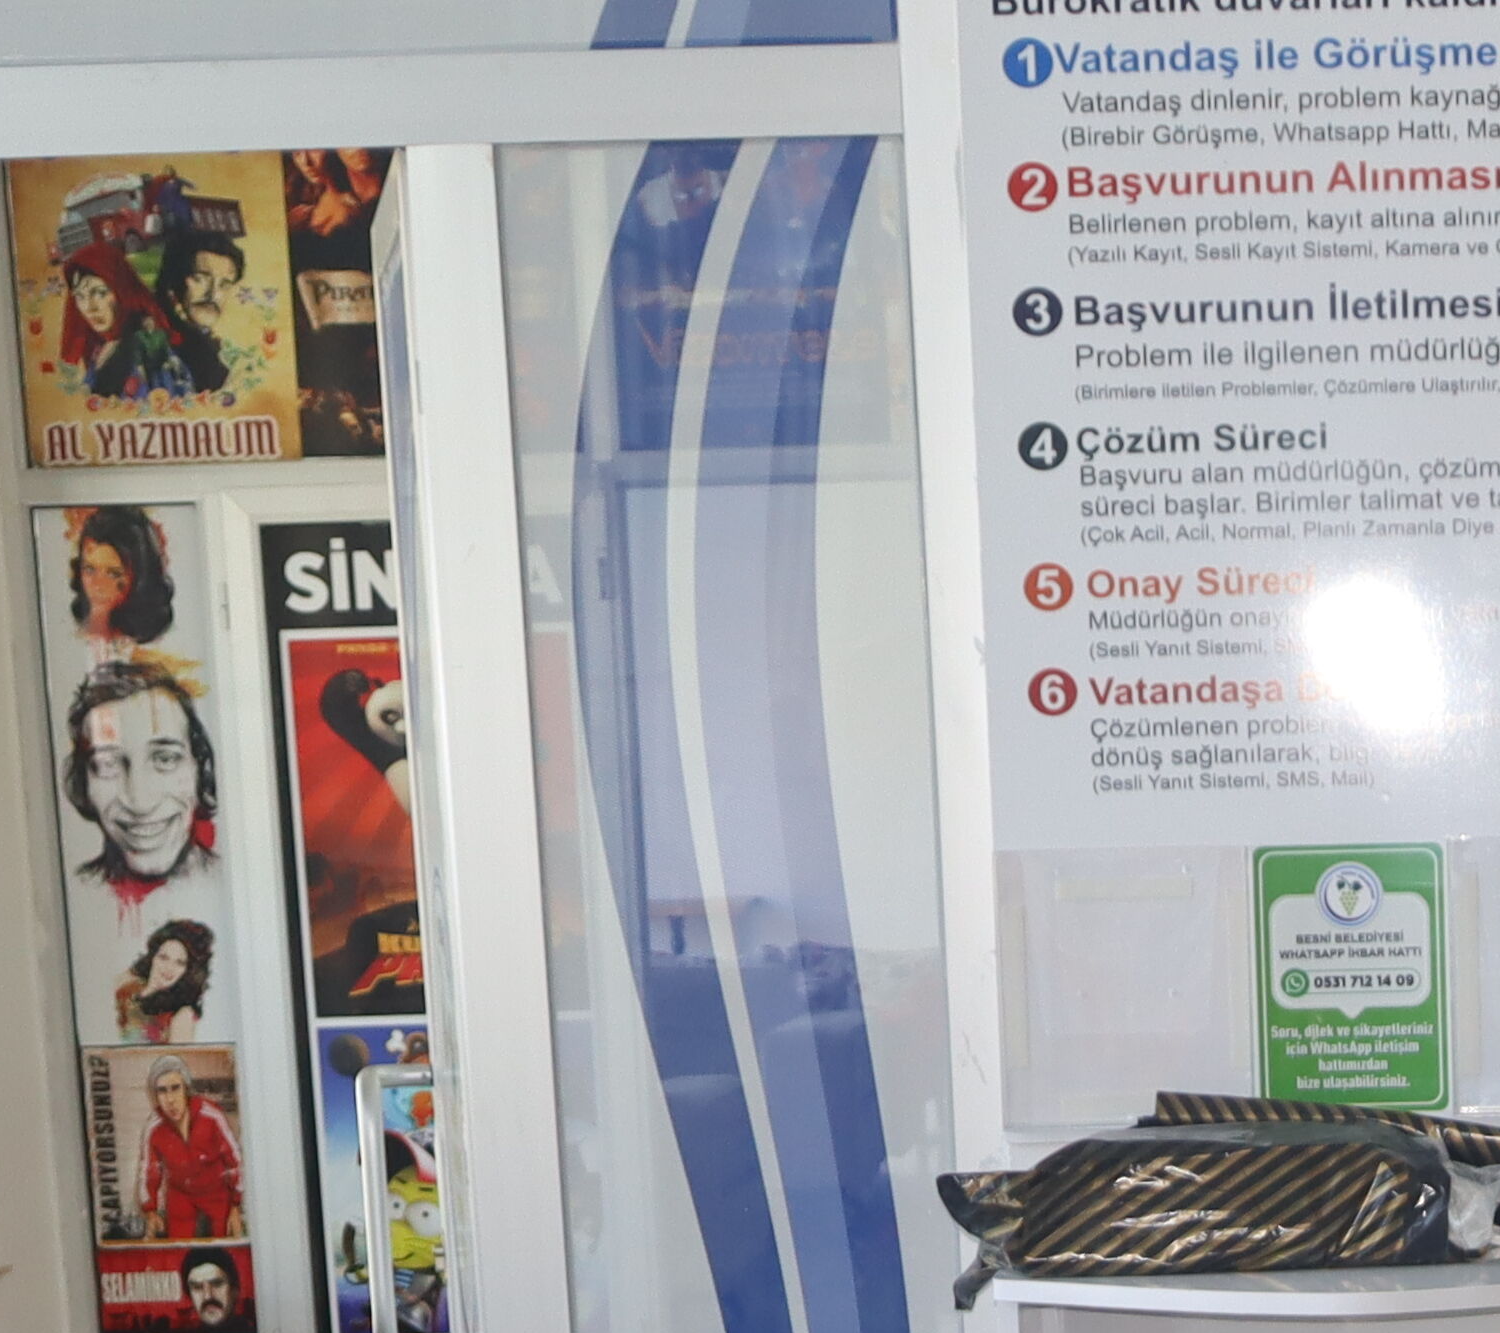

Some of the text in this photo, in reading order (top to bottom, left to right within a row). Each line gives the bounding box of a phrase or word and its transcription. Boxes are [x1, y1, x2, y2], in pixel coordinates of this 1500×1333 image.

[1054, 41, 1239, 78] Vatandaş
[1255, 39, 1298, 70] ile
[1314, 37, 1497, 75] Görüşme
[1062, 91, 1181, 117] Vatandaş
[1191, 88, 1287, 112] dinlenir,
[1299, 87, 1400, 114] problem
[1062, 126, 1144, 151] (Birebir
[1153, 125, 1264, 149] Görüşme,
[1273, 123, 1389, 145] Whatsapp
[1398, 121, 1457, 141] Hattı,
[1068, 167, 1313, 204] Başvurunun
[1069, 213, 1186, 234] Belirlenen
[1196, 211, 1297, 237] problem,
[1307, 210, 1362, 234] kayıt
[1371, 208, 1434, 228] altına
[1068, 246, 1126, 267] (Yazılı
[1134, 245, 1187, 265] Kayıt,
[1196, 243, 1240, 261] Sesli
[1248, 242, 1296, 262] Kayıt
[1303, 240, 1377, 259] Sistemi,
[1386, 239, 1460, 256] Kamera
[1467, 242, 1488, 255] ve
[1075, 296, 1313, 332] Başvurunun
[1076, 344, 1192, 368] Problem
[1204, 342, 1233, 365] ile
[1245, 341, 1358, 370] ilgilenen
[48, 418, 278, 462] AL YAZMALIM
[1077, 427, 1200, 460] Çözüm
[1215, 423, 1326, 452] Süreci
[1080, 461, 1182, 491] Başvuru
[1192, 462, 1243, 484] alan
[1254, 460, 1408, 485] müdürlüğün,
[1419, 458, 1500, 484] çözüm
[1081, 494, 1155, 517] süreci
[1165, 493, 1245, 520] başlar.
[1256, 491, 1351, 512] Birimler
[1360, 489, 1442, 510] talimat
[1452, 492, 1479, 508] ve
[1087, 569, 1183, 604] Onay
[1089, 609, 1222, 633] Müdürlüğün
[1090, 642, 1139, 662] (Sesli
[1145, 640, 1191, 656] Yanıt
[1197, 640, 1266, 656] Sistemi,
[1089, 675, 1285, 709] Vatandaşa
[1090, 716, 1238, 744] Çözümlenen
[1091, 747, 1163, 771] dönüş
[1171, 744, 1319, 769] sağlanılarak,
[1092, 770, 1374, 796] (Sesli Yanıt Sistemi, SMS, Mail)
[1296, 930, 1404, 945] BESNİ BELEDİYESİ
[1279, 948, 1345, 960] WHATSAPP
[1388, 946, 1422, 958] HATTI
[1314, 974, 1414, 988] 0531 712 14 09
[1271, 1025, 1302, 1040] Soru,
[1337, 1026, 1350, 1037] ve
[1310, 1040, 1372, 1056] WhatsApp
[1318, 1058, 1388, 1072] hattımızdan
[1297, 1076, 1321, 1090] bize
